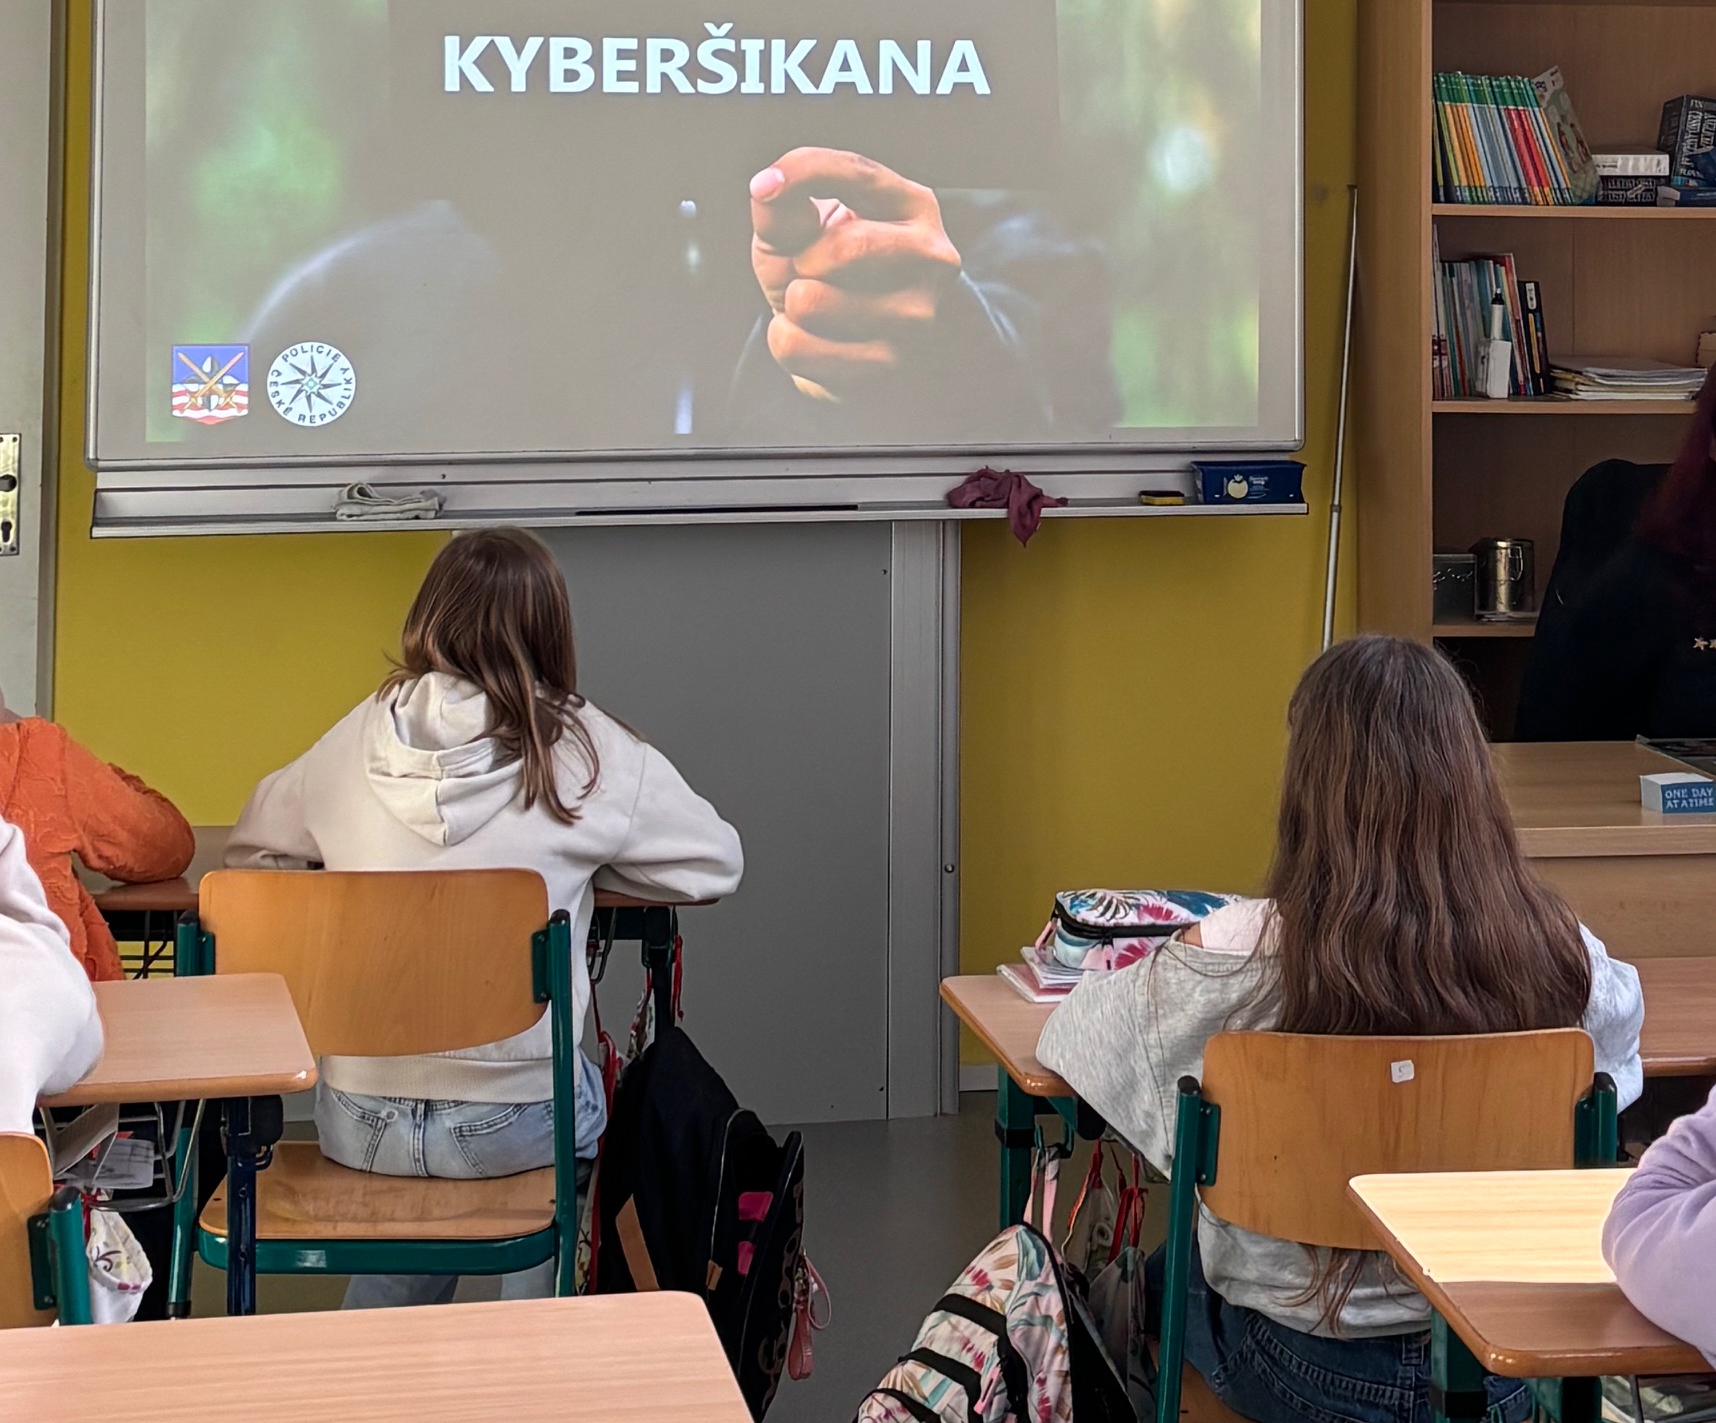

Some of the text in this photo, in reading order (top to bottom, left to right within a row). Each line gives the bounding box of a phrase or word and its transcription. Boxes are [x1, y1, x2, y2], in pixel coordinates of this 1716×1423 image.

[444, 22, 991, 95] KYBERŠIKANA
[281, 344, 341, 363] POLICIE
[298, 367, 353, 424] REPUBLIKY
[1665, 787, 1713, 799] ONE DAY
[1666, 798, 1680, 809] AT
